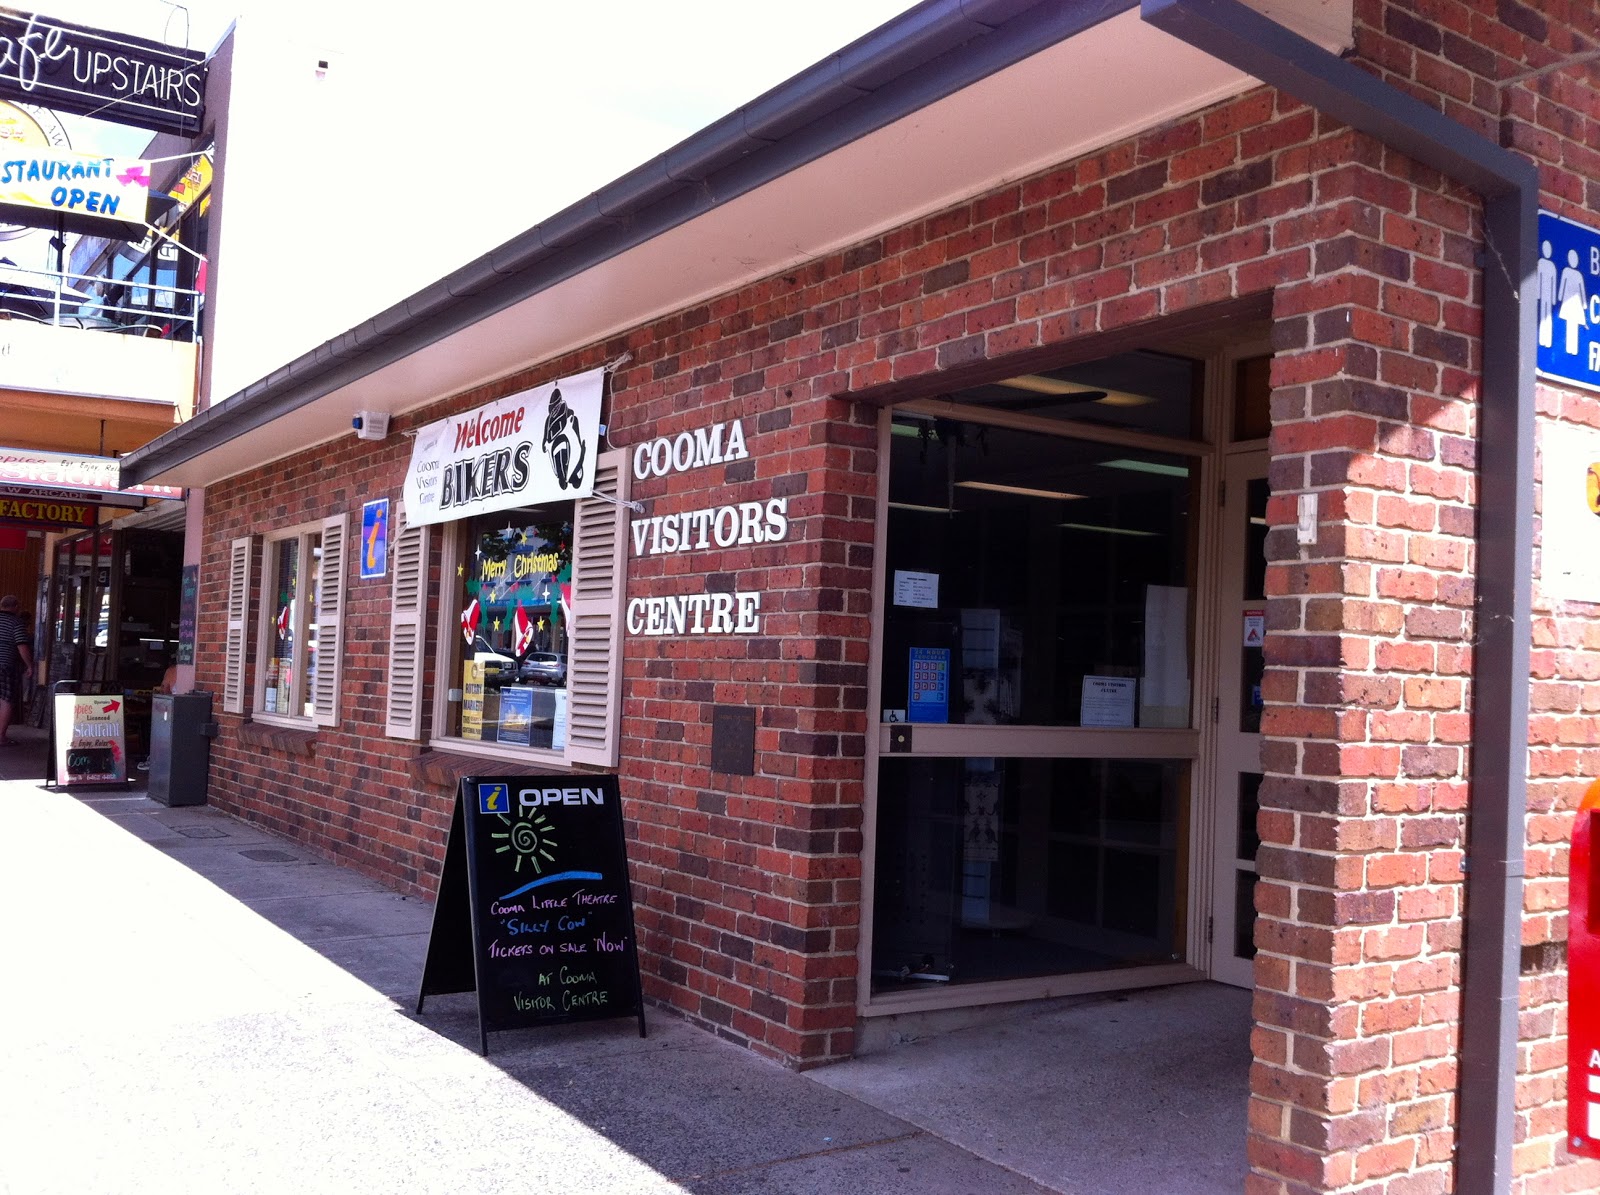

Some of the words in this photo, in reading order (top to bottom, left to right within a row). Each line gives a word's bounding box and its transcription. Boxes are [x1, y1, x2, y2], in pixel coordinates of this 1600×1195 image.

[73, 47, 200, 106] UPSTAIRS
[51, 186, 120, 215] OPEN
[454, 406, 525, 453] Welcome
[633, 419, 749, 480] COOMA
[439, 441, 533, 511] BIKERS
[0, 500, 88, 523] FACTORY
[631, 498, 788, 556] VISITORS
[481, 557, 507, 581] Merry
[514, 552, 559, 578] Christmas
[626, 591, 760, 636] CENTRE
[519, 788, 604, 806] OPEN
[538, 974, 552, 985] AT
[513, 991, 555, 1011] VISITOR
[562, 989, 608, 1012] CENTRE
